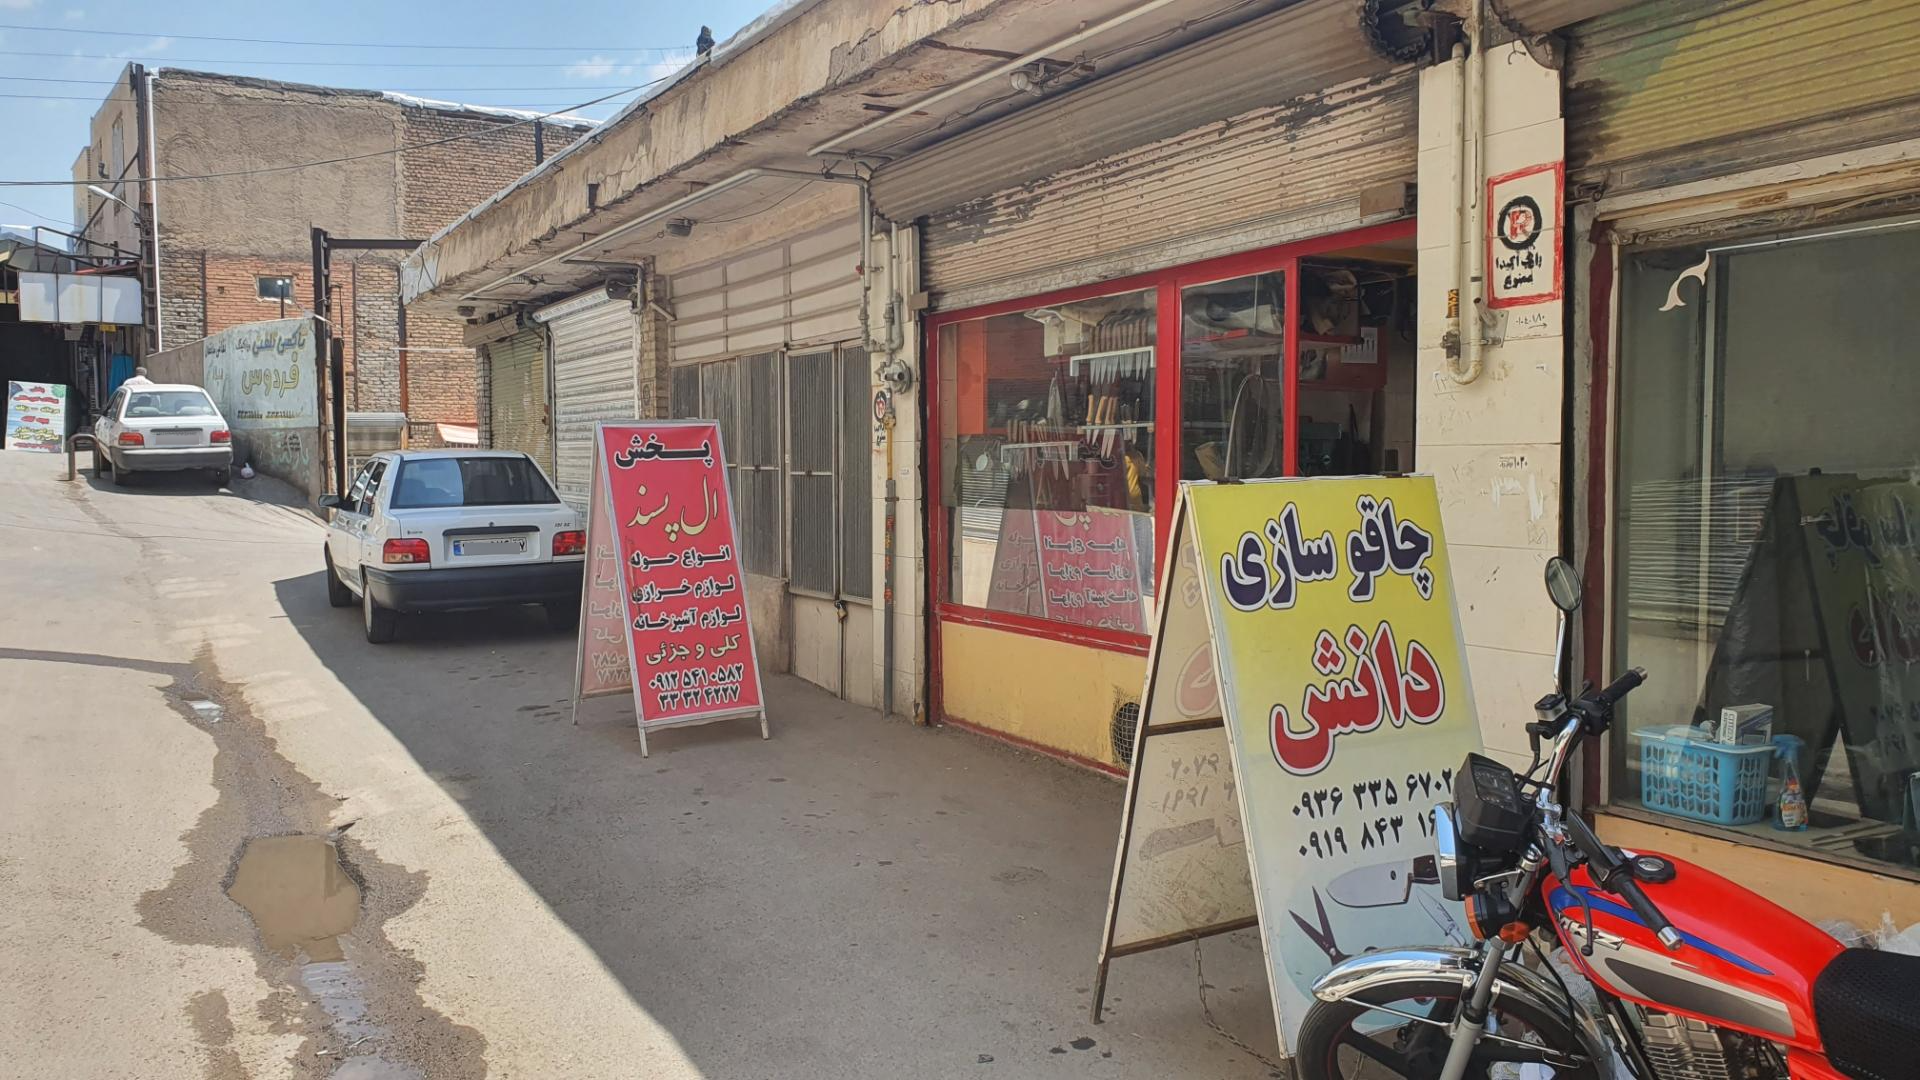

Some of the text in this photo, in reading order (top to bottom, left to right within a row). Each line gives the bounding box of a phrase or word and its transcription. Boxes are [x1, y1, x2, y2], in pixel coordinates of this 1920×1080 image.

[1504, 272, 1534, 290] ممنوع
[242, 351, 299, 398] فردوس
[615, 434, 713, 468] پخش
[626, 474, 718, 542] ال پسند
[629, 549, 678, 572] حوله
[681, 545, 731, 568] انواع
[1220, 495, 1435, 612] چاقو سازی
[631, 575, 735, 603] لوازم خرازی
[633, 604, 742, 633] لوازم آشپزخانه
[646, 634, 741, 665] کلی و جزئی
[649, 663, 744, 692] ۰۹۱۲ ۵۴۱ ۰۵۸۲
[658, 684, 740, 713] ۳۳ ۳۲ ۴۲۲۷
[1269, 620, 1445, 776] دانش
[1292, 786, 1343, 819] ۰۹۳۶
[1352, 778, 1398, 811] ۳۳۵
[1405, 767, 1452, 802] ۶۷۰۲
[1299, 826, 1348, 859] ۰۹۱۹
[1361, 815, 1404, 850] ۸۴۳
